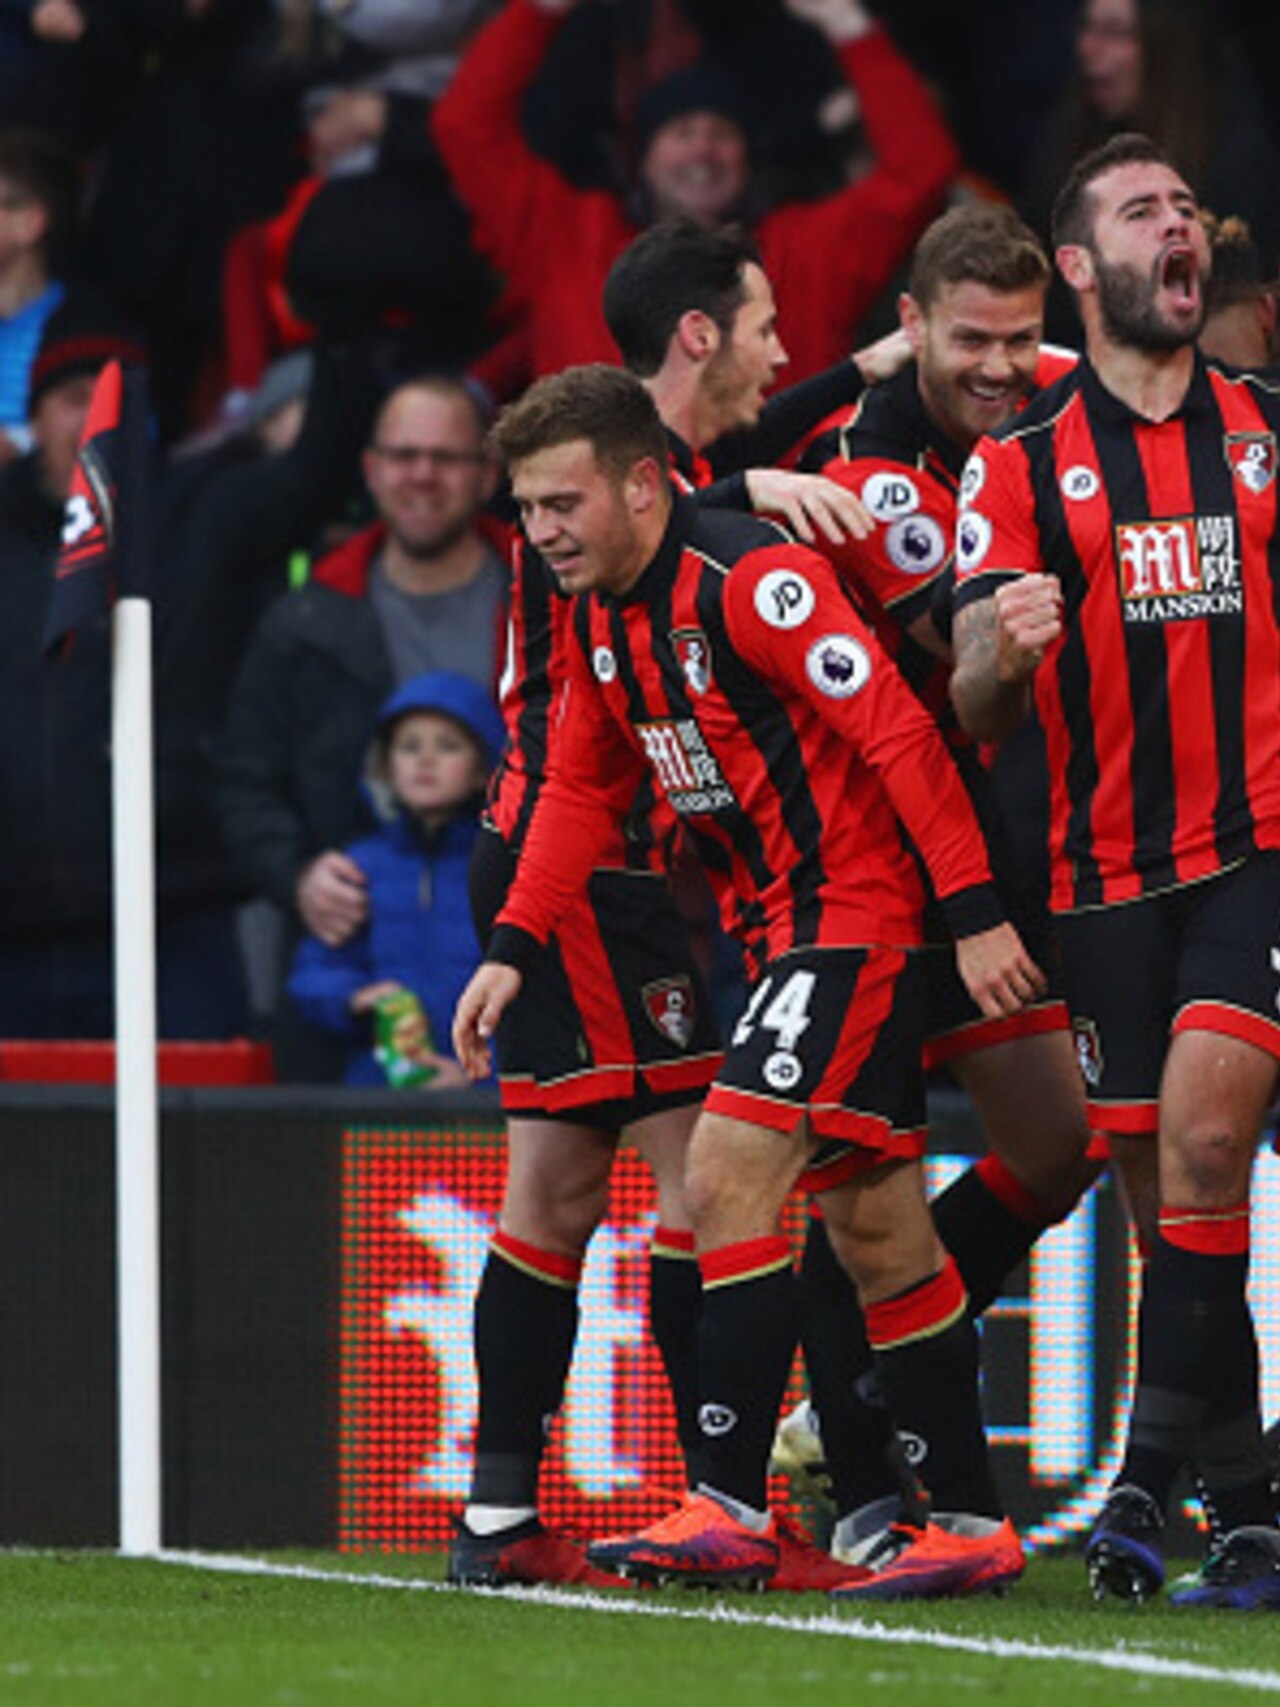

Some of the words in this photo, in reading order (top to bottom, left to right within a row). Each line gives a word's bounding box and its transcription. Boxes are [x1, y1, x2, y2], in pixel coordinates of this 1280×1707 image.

[875, 482, 911, 510] JD
[769, 579, 803, 621] JD
[1124, 591, 1242, 622] MANSION
